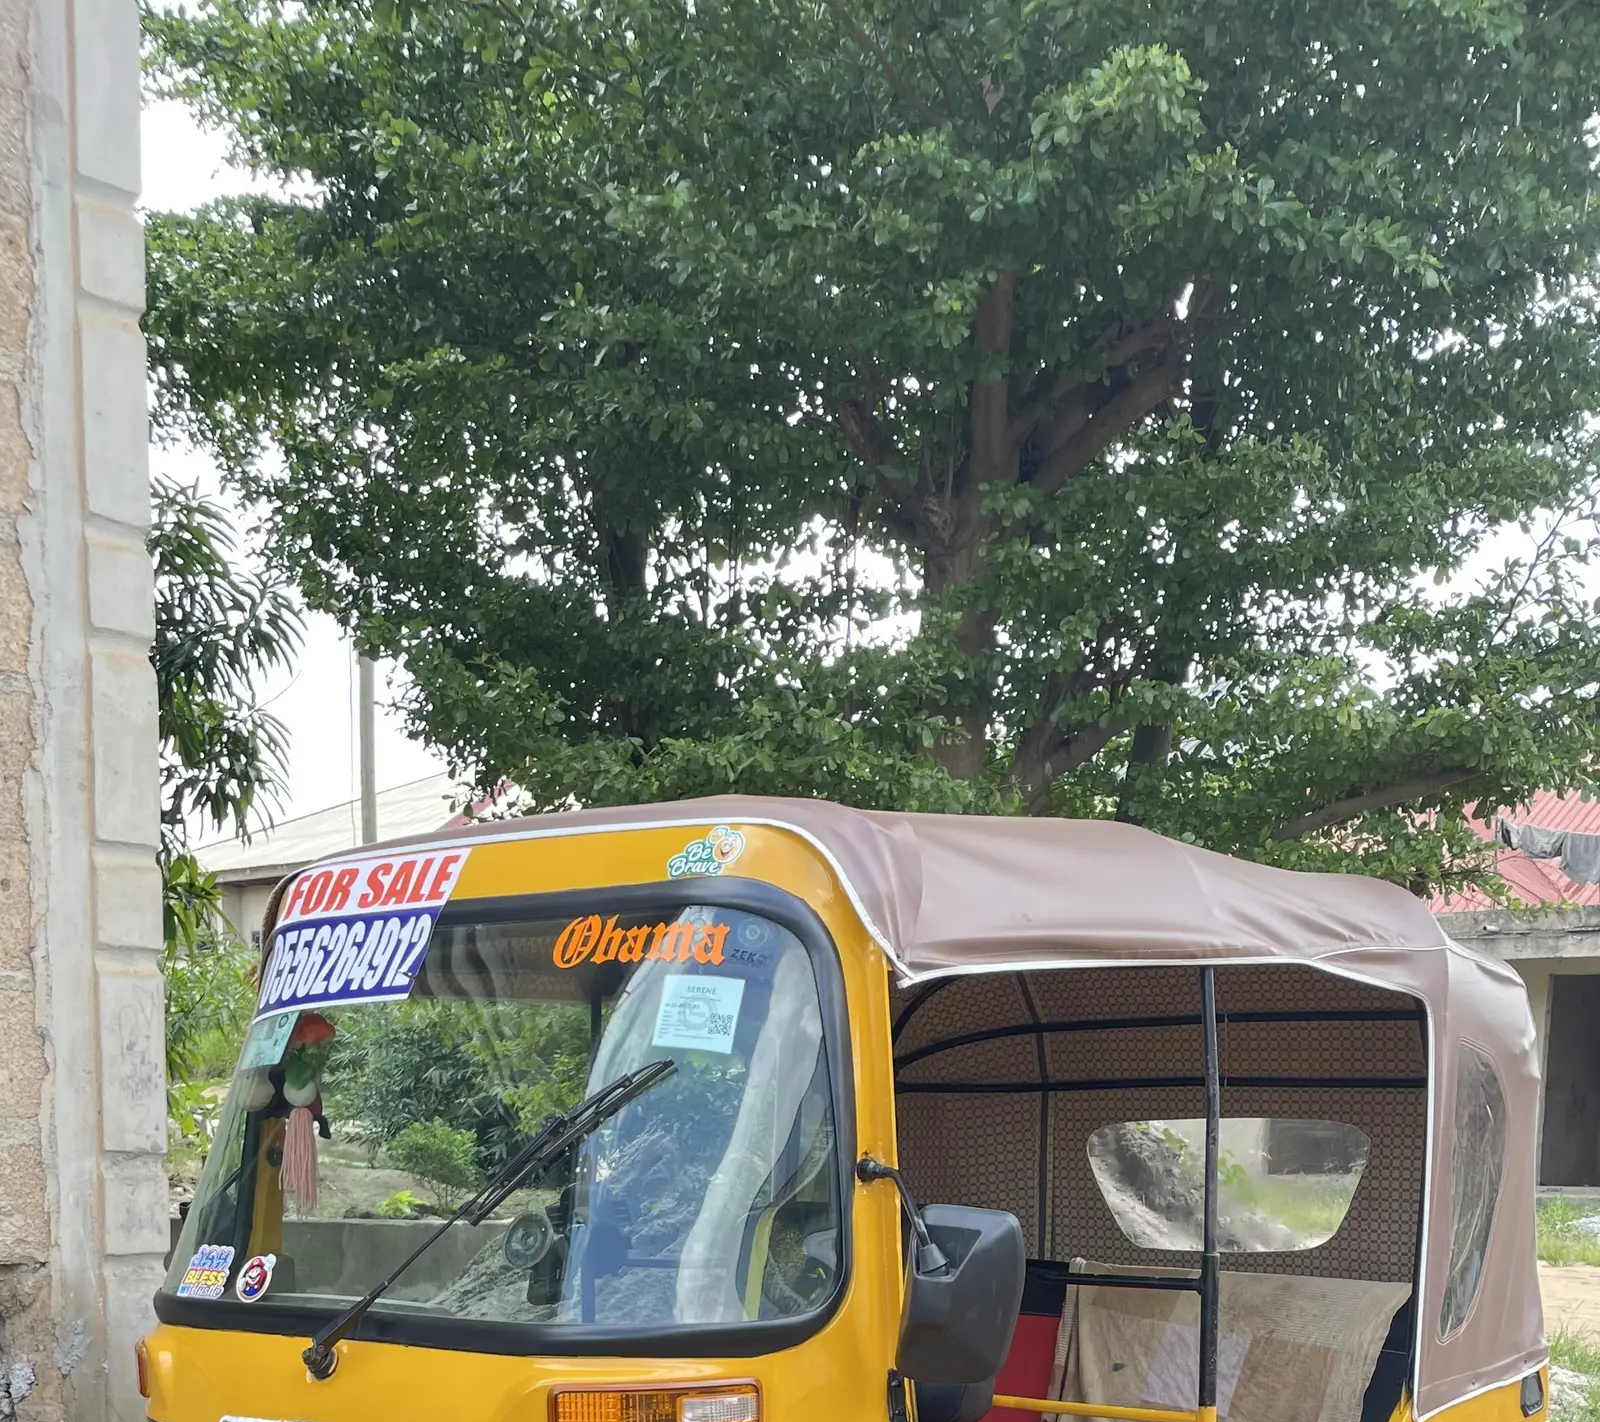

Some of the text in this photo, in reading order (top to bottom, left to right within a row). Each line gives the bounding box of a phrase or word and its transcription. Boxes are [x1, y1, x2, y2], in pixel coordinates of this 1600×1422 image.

[687, 842, 712, 861] Be
[669, 857, 720, 876] Brave
[283, 854, 462, 921] FOR SALE
[552, 913, 731, 970] Obama
[686, 986, 718, 995] SERENE
[183, 1269, 227, 1286] BLESS
